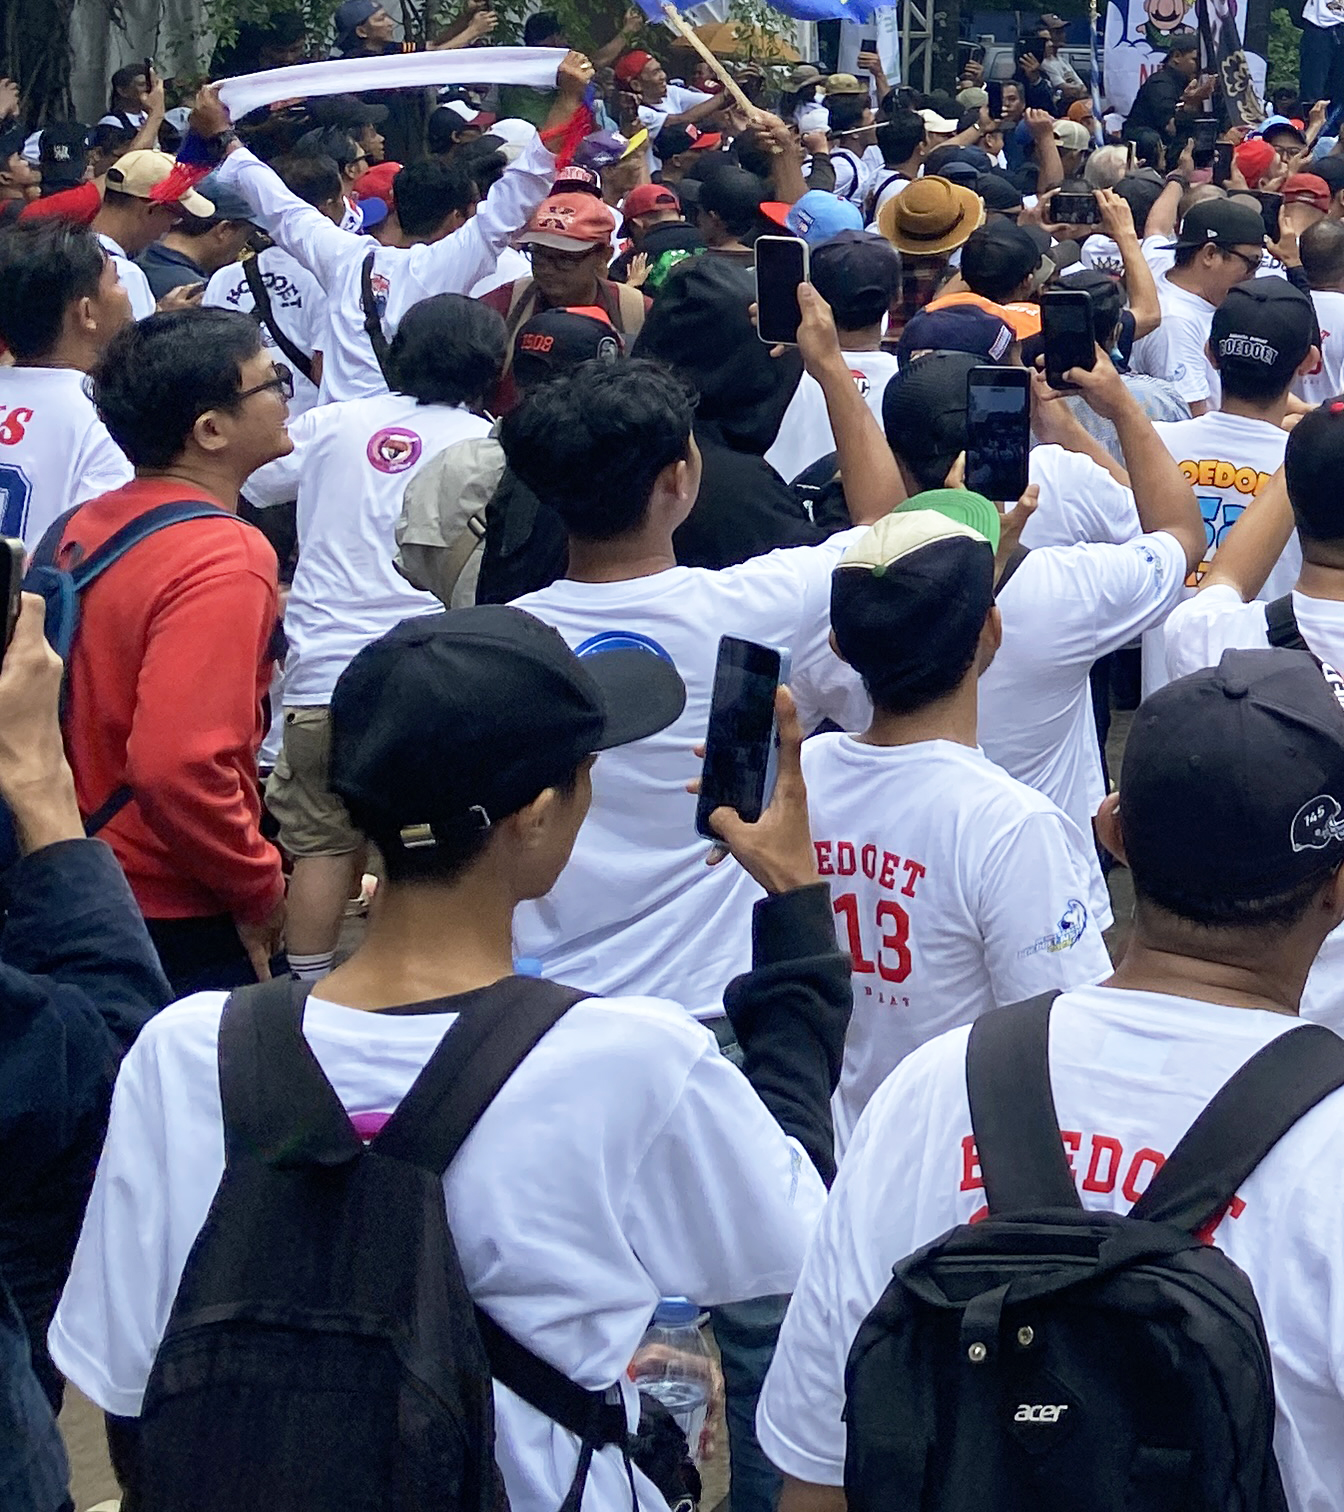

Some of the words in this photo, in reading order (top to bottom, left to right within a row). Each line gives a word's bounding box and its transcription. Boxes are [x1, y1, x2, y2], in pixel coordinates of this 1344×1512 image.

[1303, 804, 1326, 827] 145
[832, 892, 912, 984] 13
[1014, 1404, 1068, 1423] acer
